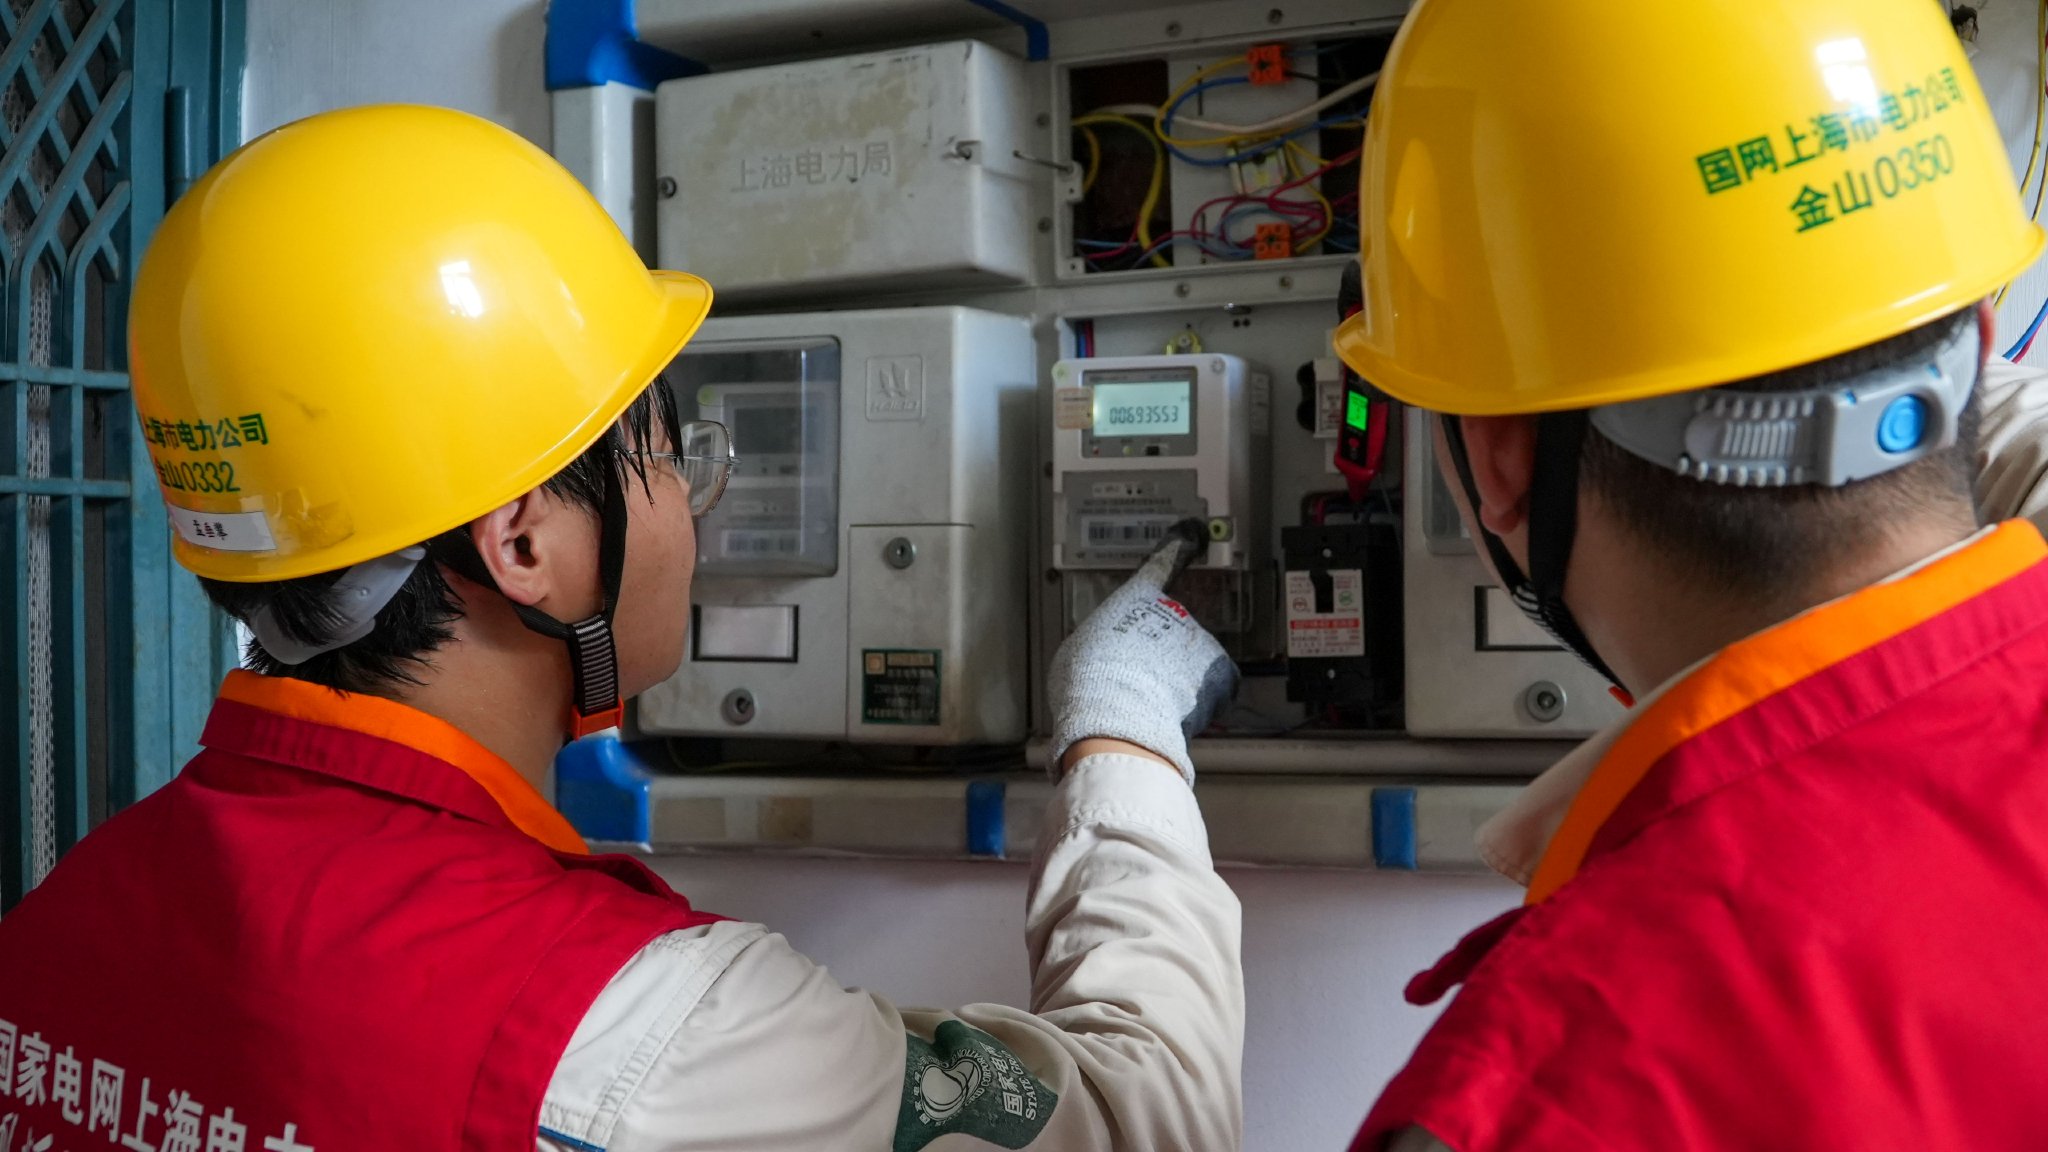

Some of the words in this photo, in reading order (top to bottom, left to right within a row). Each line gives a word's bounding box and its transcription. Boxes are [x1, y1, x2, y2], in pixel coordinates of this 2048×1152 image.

[730, 141, 892, 193] 上海电力局
[1695, 66, 1966, 195] 国网上海市电力公司
[1789, 133, 1954, 233] 金山0350
[1109, 405, 1180, 424] 00693553
